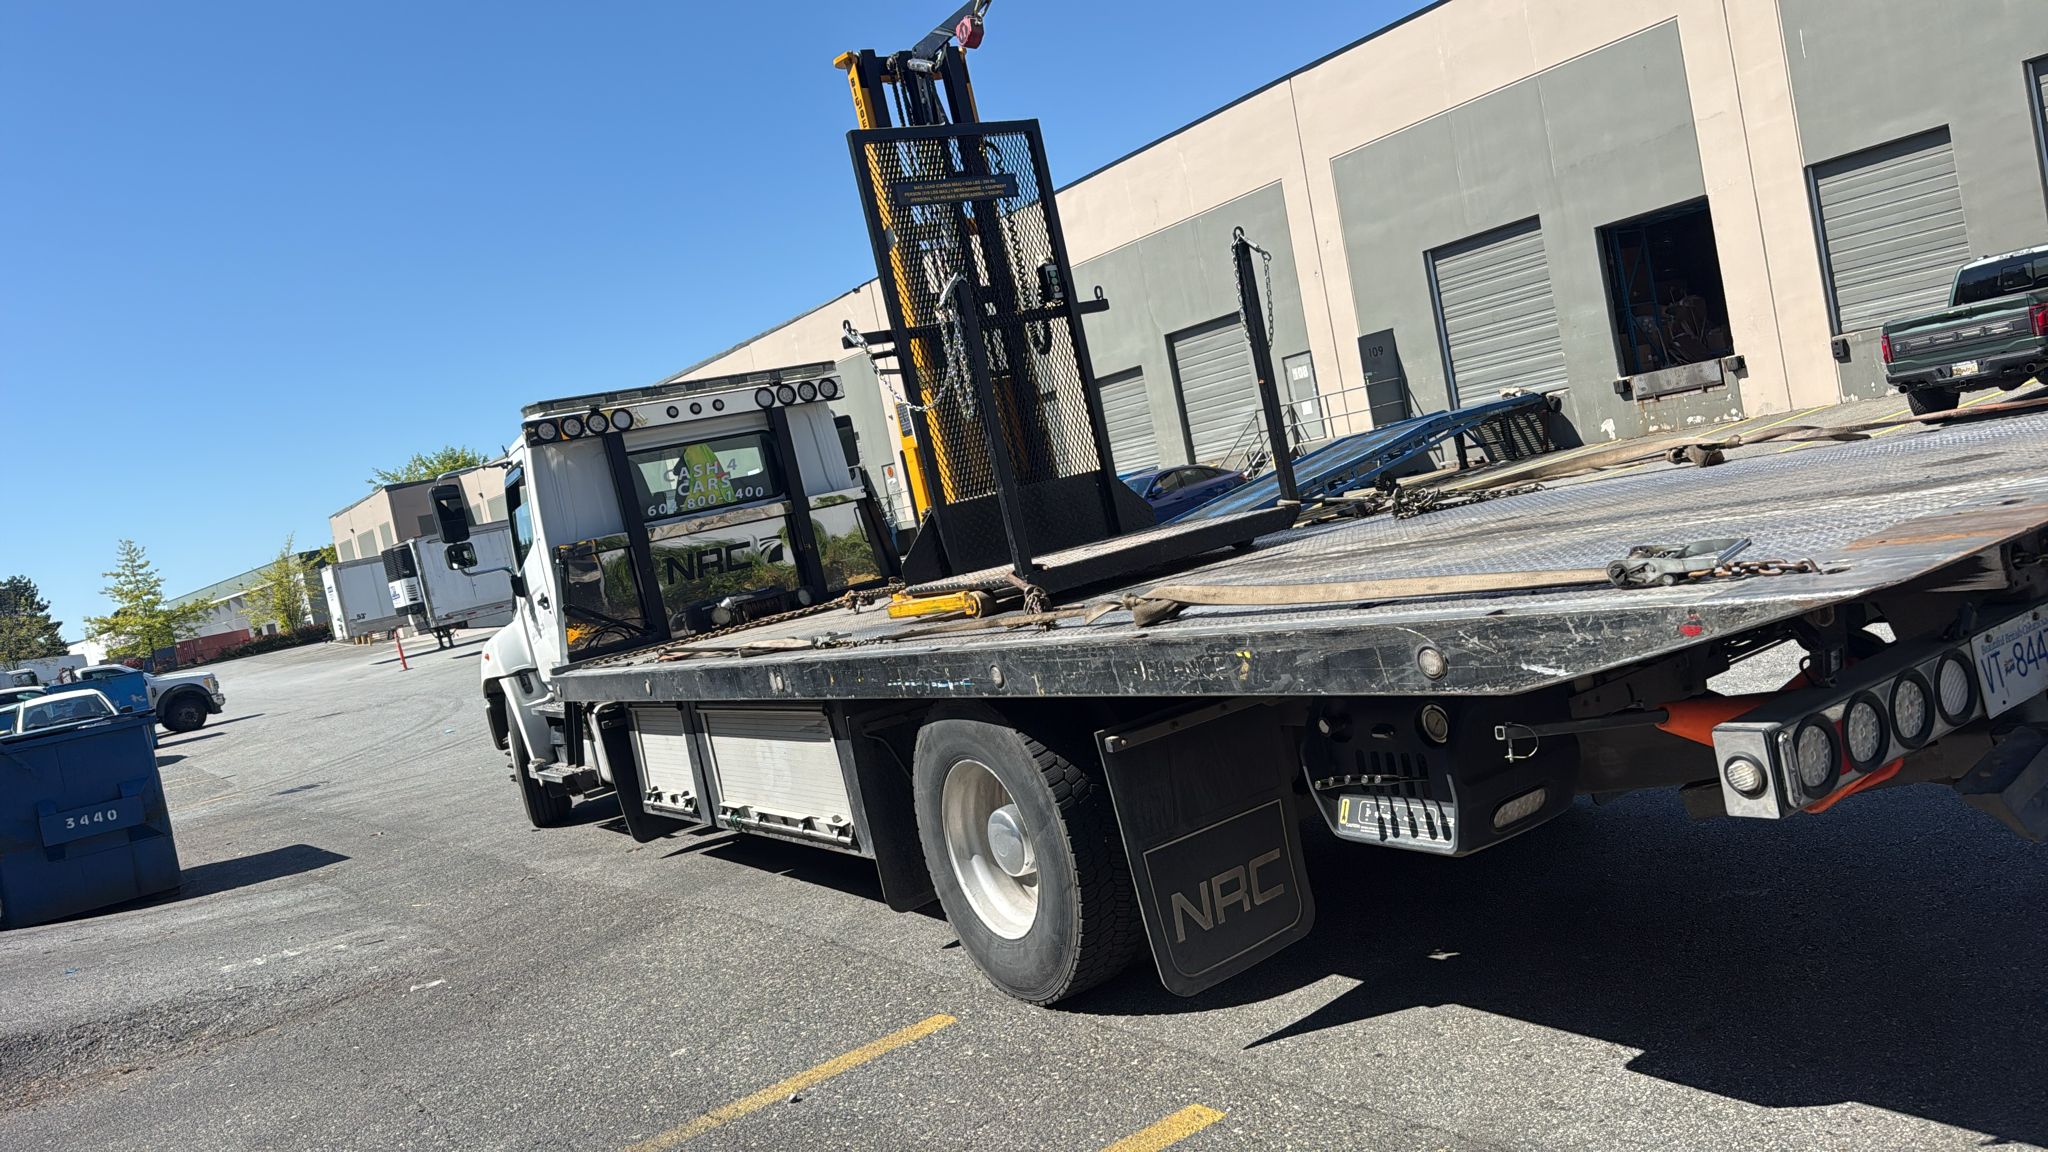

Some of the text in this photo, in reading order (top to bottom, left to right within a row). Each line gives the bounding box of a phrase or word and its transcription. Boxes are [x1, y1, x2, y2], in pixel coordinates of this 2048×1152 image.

[1368, 346, 1384, 357] 109
[663, 458, 738, 482] CASH 4
[677, 475, 731, 496] CARS
[647, 486, 764, 516] 604-800-1400
[666, 541, 752, 585] NRC
[1981, 628, 2048, 694] VT 844
[65, 809, 118, 829] 3440
[1171, 848, 1285, 944] NRC
